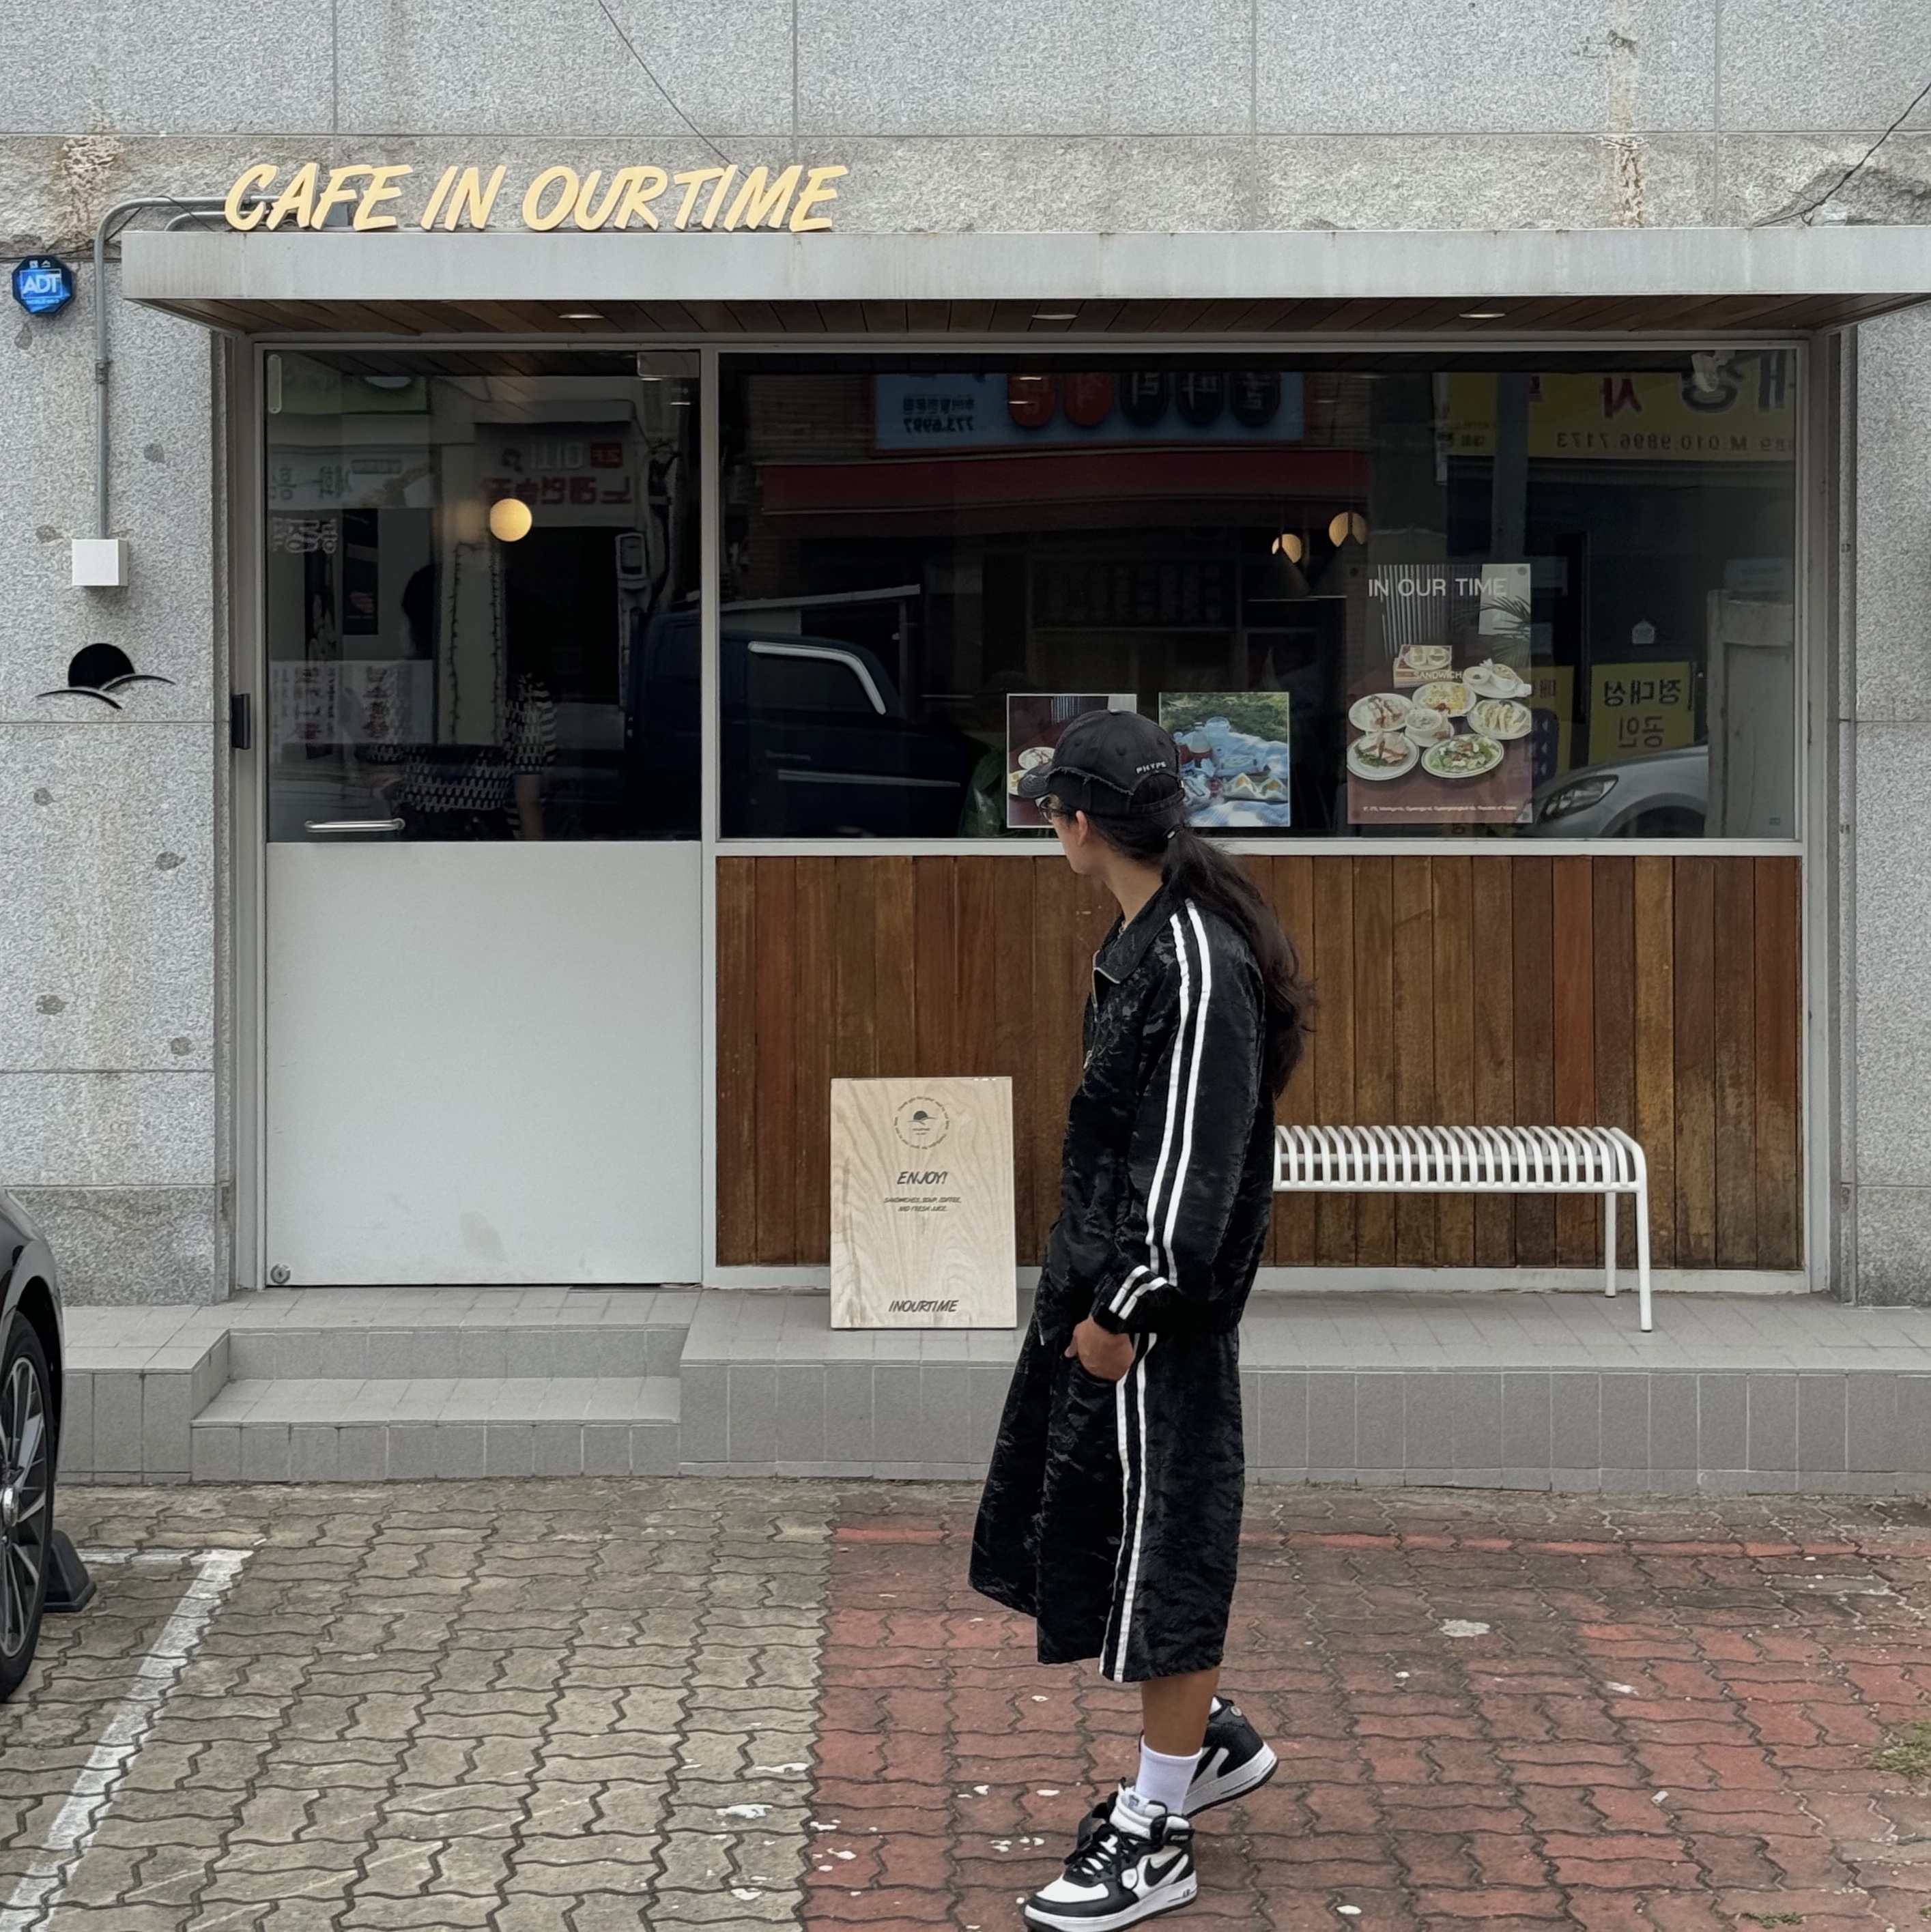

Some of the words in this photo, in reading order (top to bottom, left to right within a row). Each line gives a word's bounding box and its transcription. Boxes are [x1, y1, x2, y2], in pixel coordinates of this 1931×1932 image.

[225, 162, 414, 231] CAFE
[420, 164, 507, 231] IN
[23, 274, 61, 293] ADT
[1368, 578, 1390, 597] IN
[1398, 578, 1446, 597] OUR
[1455, 578, 1507, 596] TIME
[1414, 671, 1463, 680] SANDWICH
[897, 1171, 949, 1185] ENJOY!
[889, 1299, 960, 1313] INOURTIME
